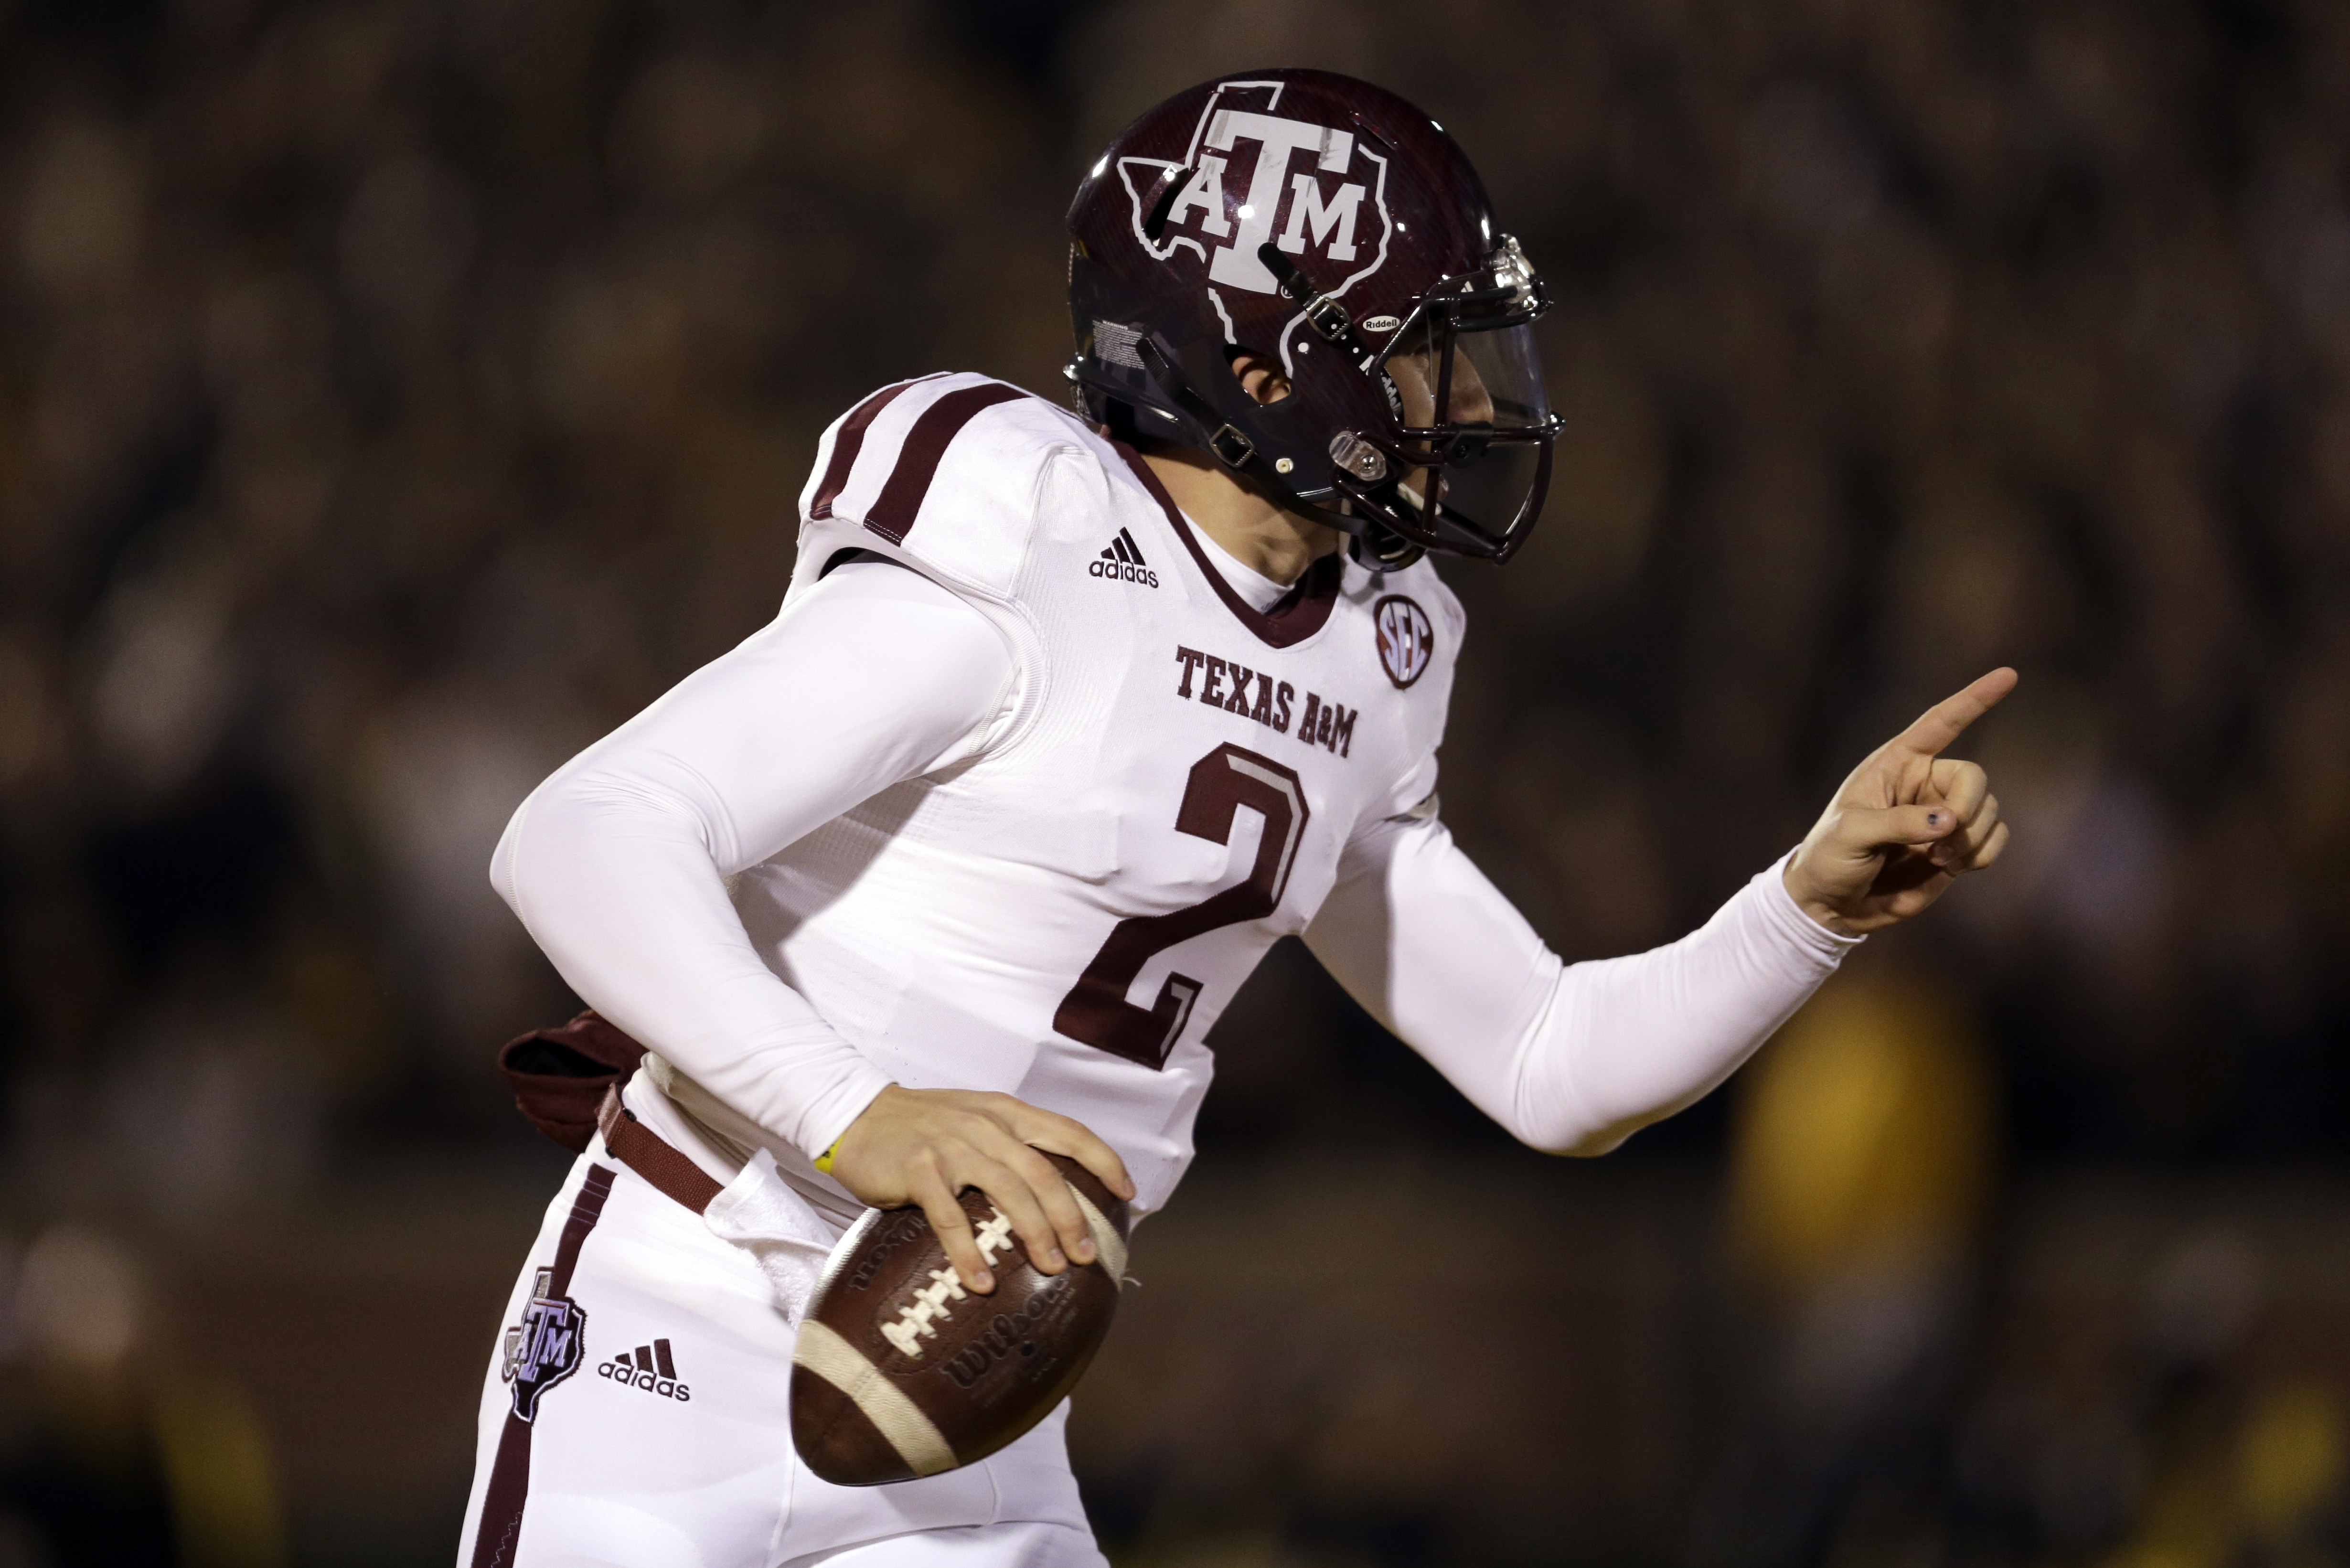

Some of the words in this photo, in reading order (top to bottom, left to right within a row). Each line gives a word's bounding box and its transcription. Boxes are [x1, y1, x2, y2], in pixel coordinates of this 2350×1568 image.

[1366, 319, 1397, 330] Riddell
[1089, 559, 1159, 588] adidas
[1379, 602, 1430, 682] SEC
[1175, 644, 1294, 734] TEXAS
[1297, 691, 1358, 759] A&M
[1052, 742, 1310, 1072] 2
[938, 1272, 1072, 1389] Wilson
[598, 1362, 691, 1402] adidas
